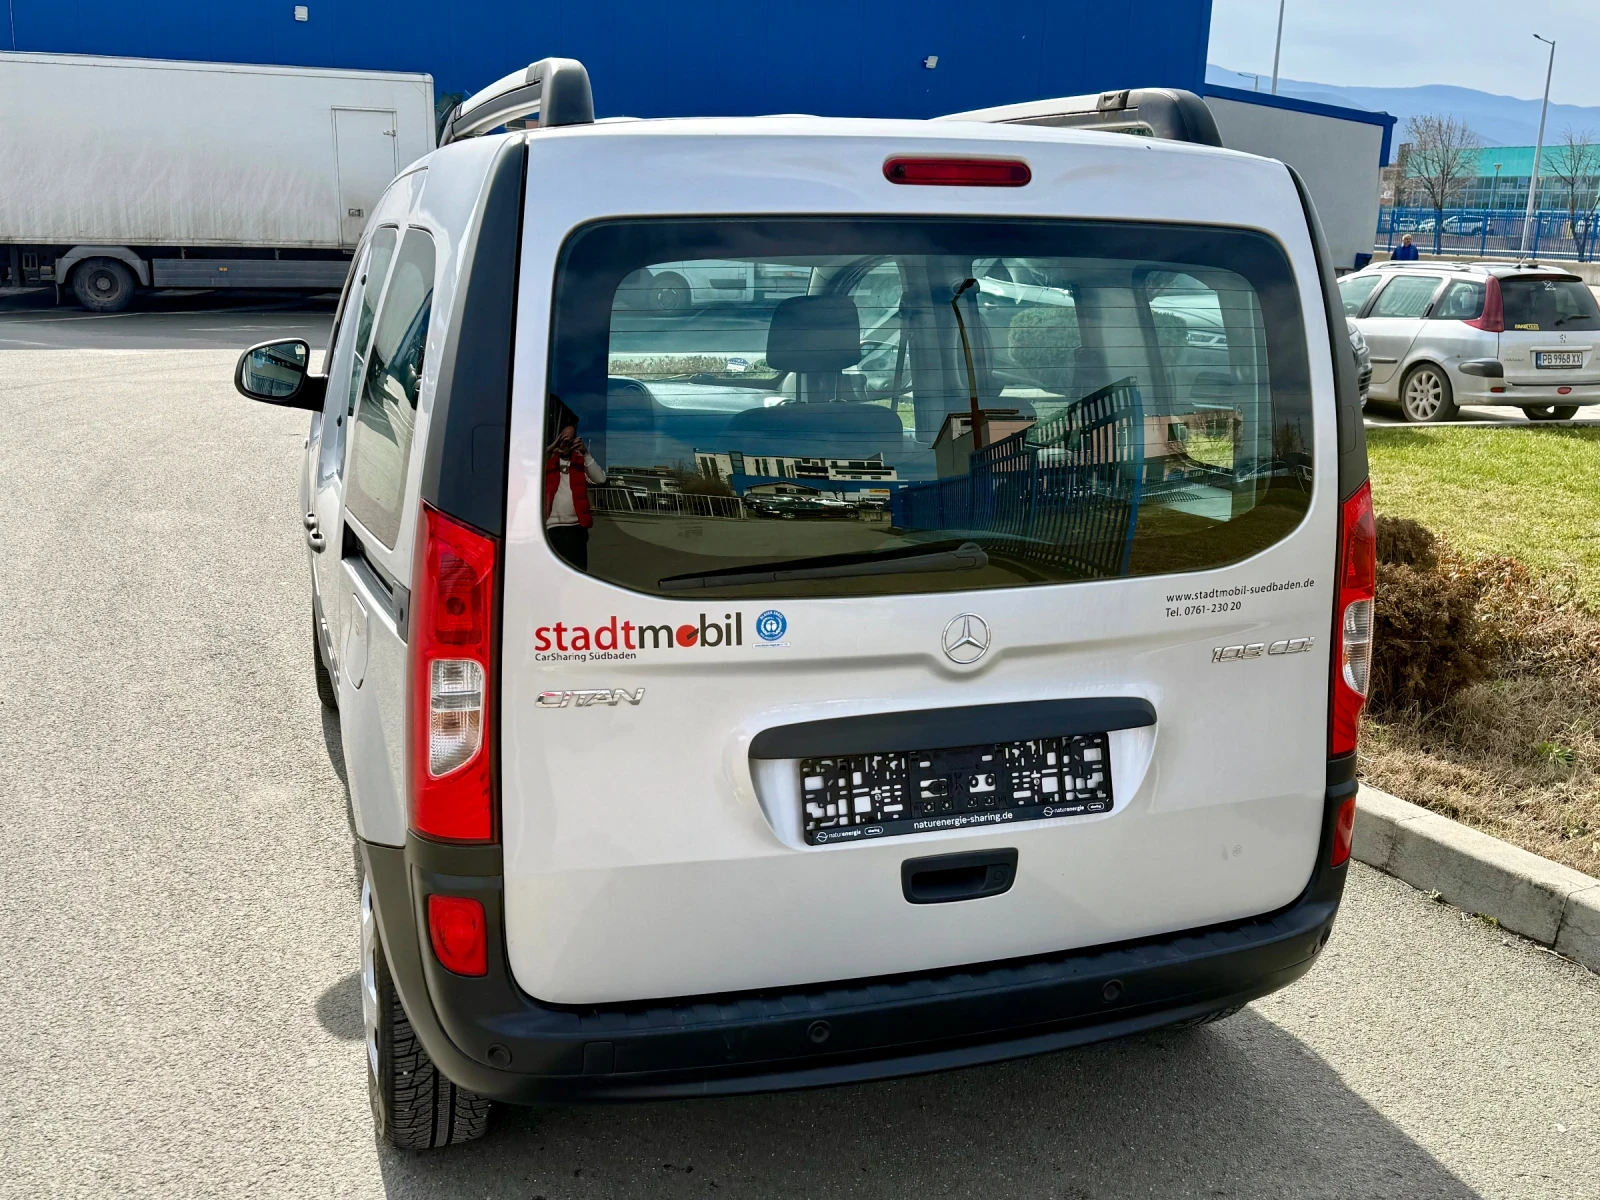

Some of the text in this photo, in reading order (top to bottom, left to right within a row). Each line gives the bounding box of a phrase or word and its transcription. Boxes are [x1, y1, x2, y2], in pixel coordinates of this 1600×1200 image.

[1542, 354, 1552, 364] PB
[1571, 353, 1581, 363] XX
[1166, 577, 1315, 603] www.stadtmobil-suedbaden.de
[1165, 606, 1182, 618] Tel.
[1230, 601, 1242, 611] 20
[534, 612, 743, 652] stadtmobil
[534, 651, 637, 663] CarSharing Südbaden
[535, 688, 646, 709] CITAN
[913, 811, 1013, 830] naturenergie-sharing.de
